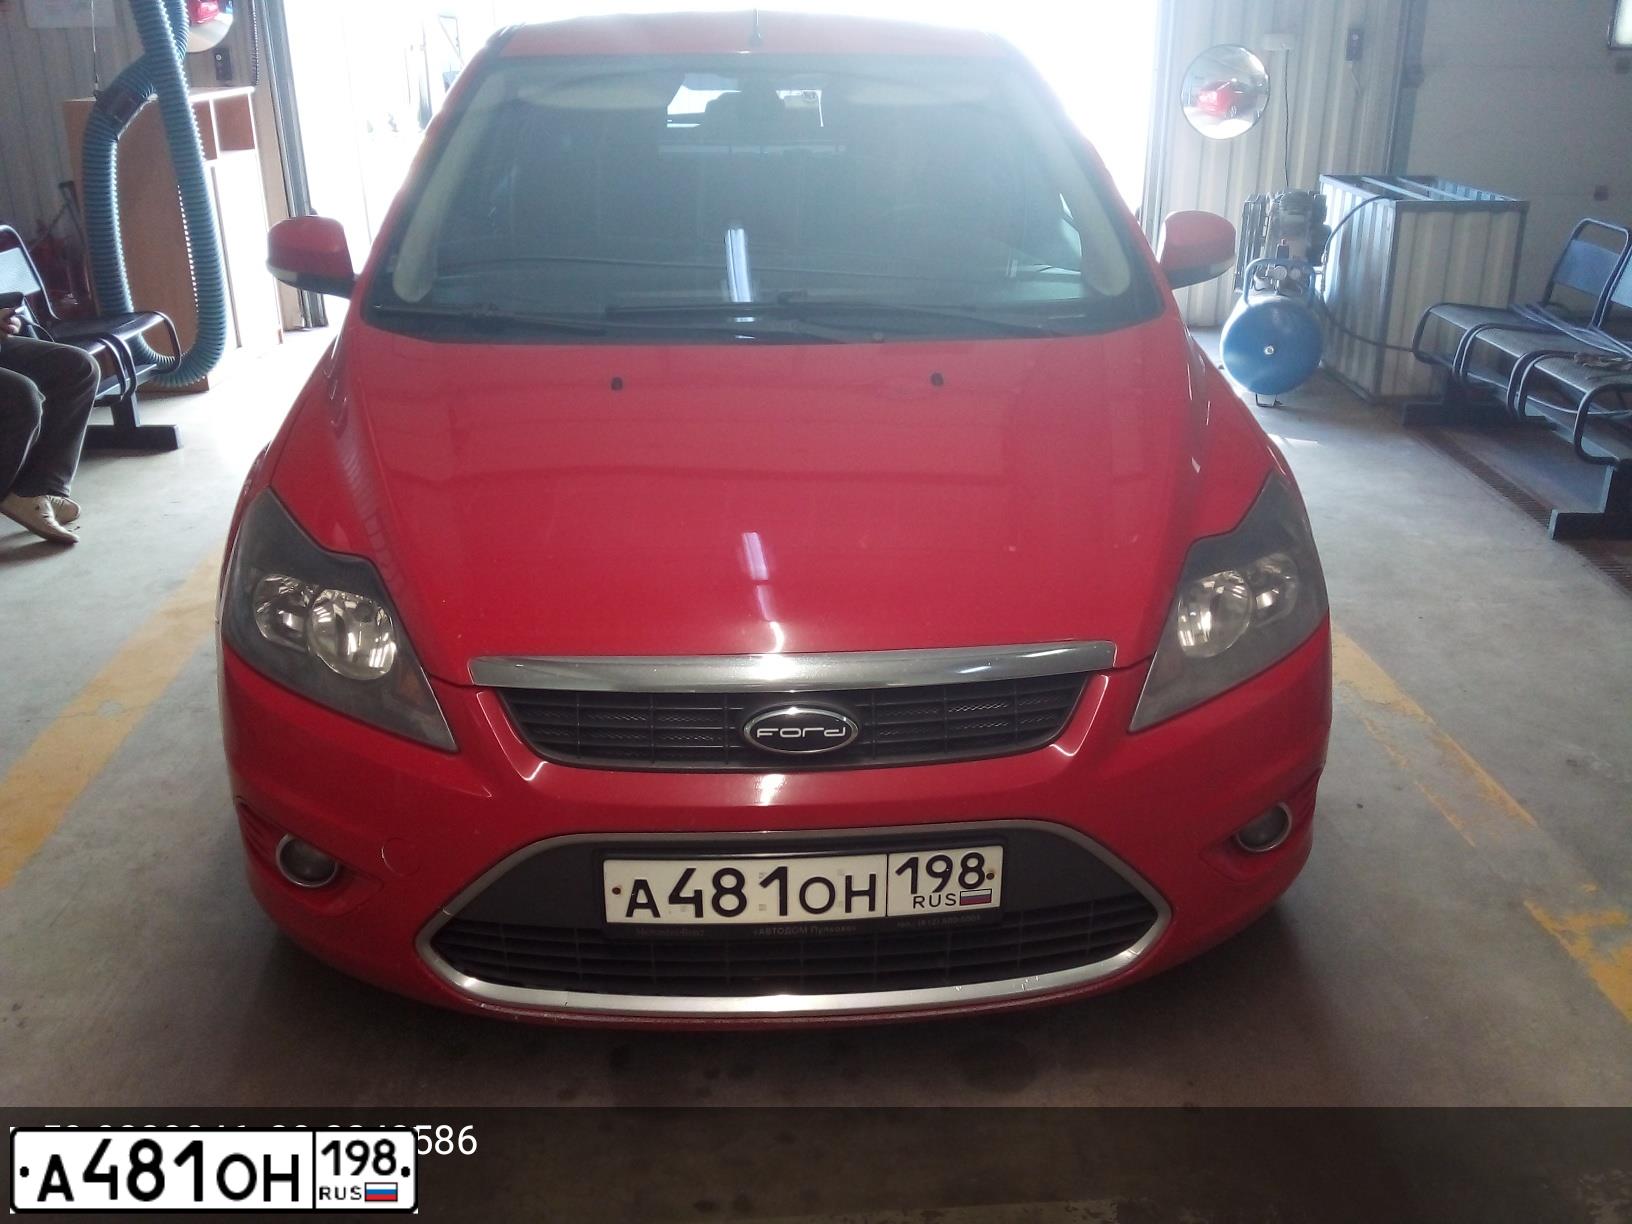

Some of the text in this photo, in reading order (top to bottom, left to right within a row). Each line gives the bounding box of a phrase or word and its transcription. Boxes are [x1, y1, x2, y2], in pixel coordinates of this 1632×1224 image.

[756, 726, 846, 738] Ford
[894, 852, 986, 895] 198
[912, 893, 957, 909] RUS
